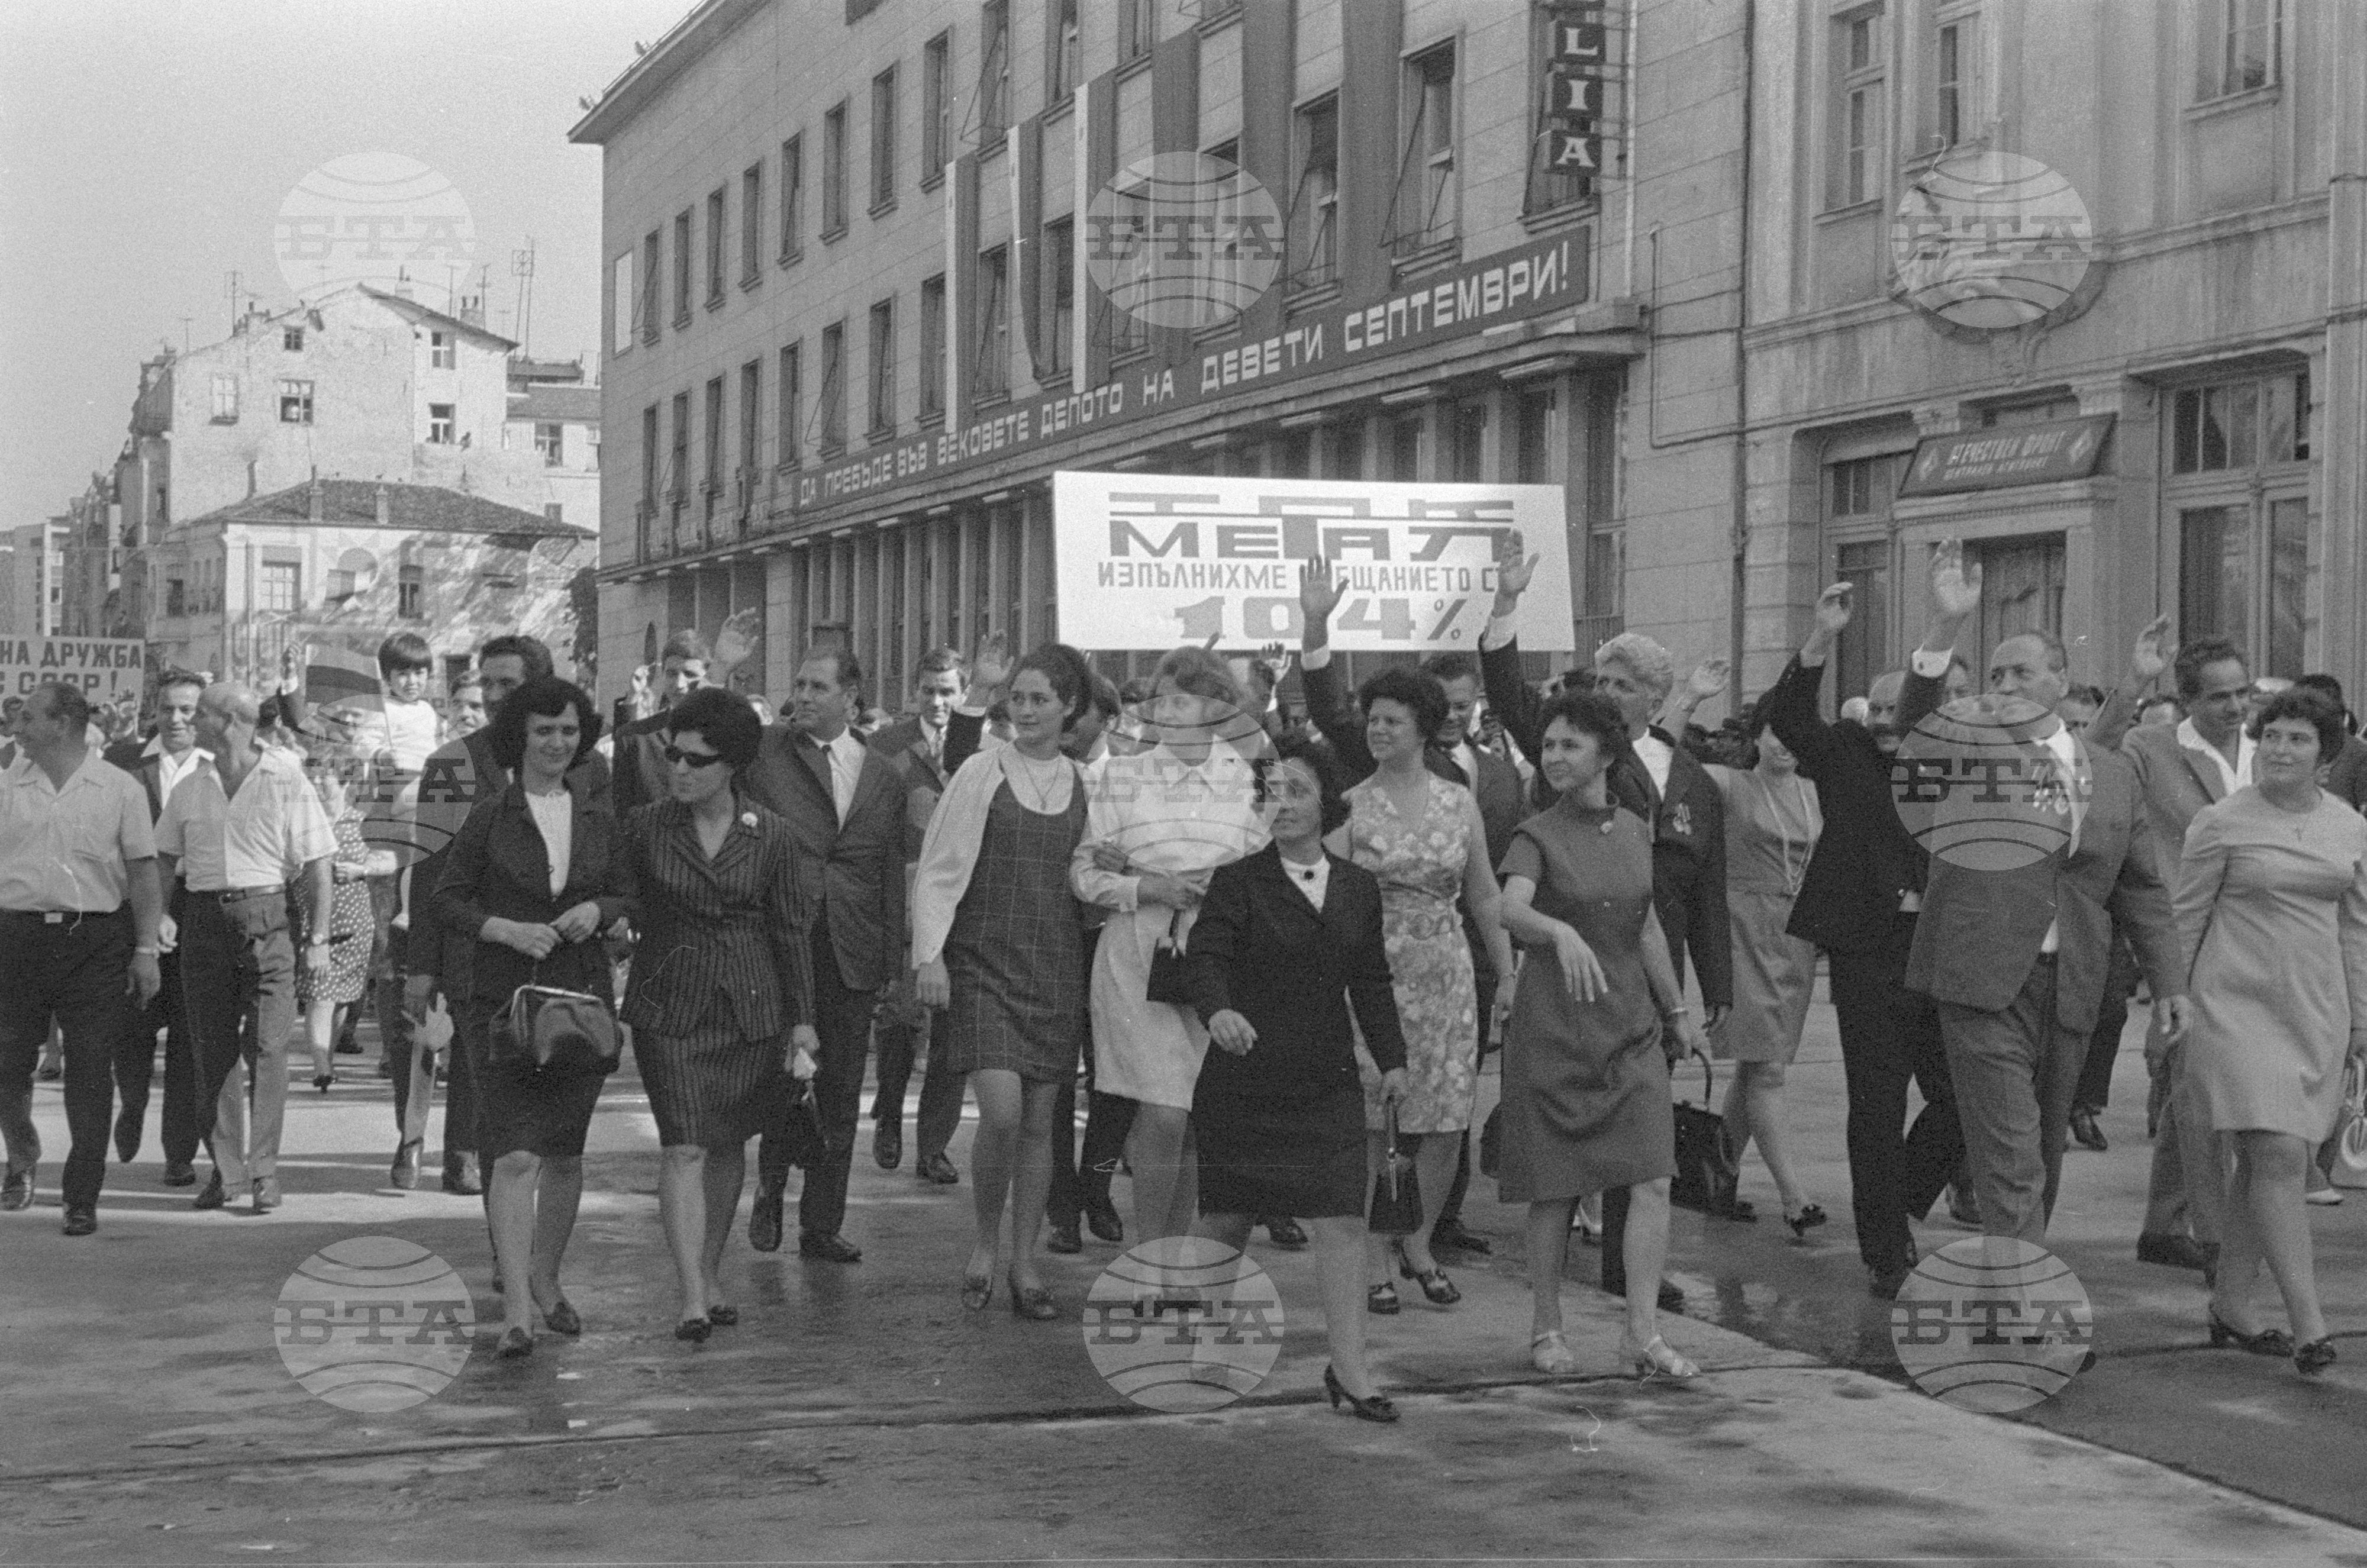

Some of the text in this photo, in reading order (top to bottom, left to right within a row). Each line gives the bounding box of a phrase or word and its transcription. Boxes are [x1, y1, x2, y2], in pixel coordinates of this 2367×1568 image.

[800, 478, 816, 509] ДА
[897, 442, 927, 477] ВЪВ
[937, 409, 1029, 466] ВЕКОВЕТЕ
[1142, 368, 1174, 406] НА
[1201, 322, 1323, 395] ДЕВЕТИ
[1344, 240, 1569, 353] СЕПТЕМВРИ!
[1109, 514, 1513, 562] МЕТАЛ
[1098, 561, 1287, 589] ИЗПЪЛНИХМЕ
[1300, 563, 1471, 592] ЕЩАНИЕТО
[1174, 595, 1468, 641] 104%
[39, 641, 141, 669] ДРУЖБА
